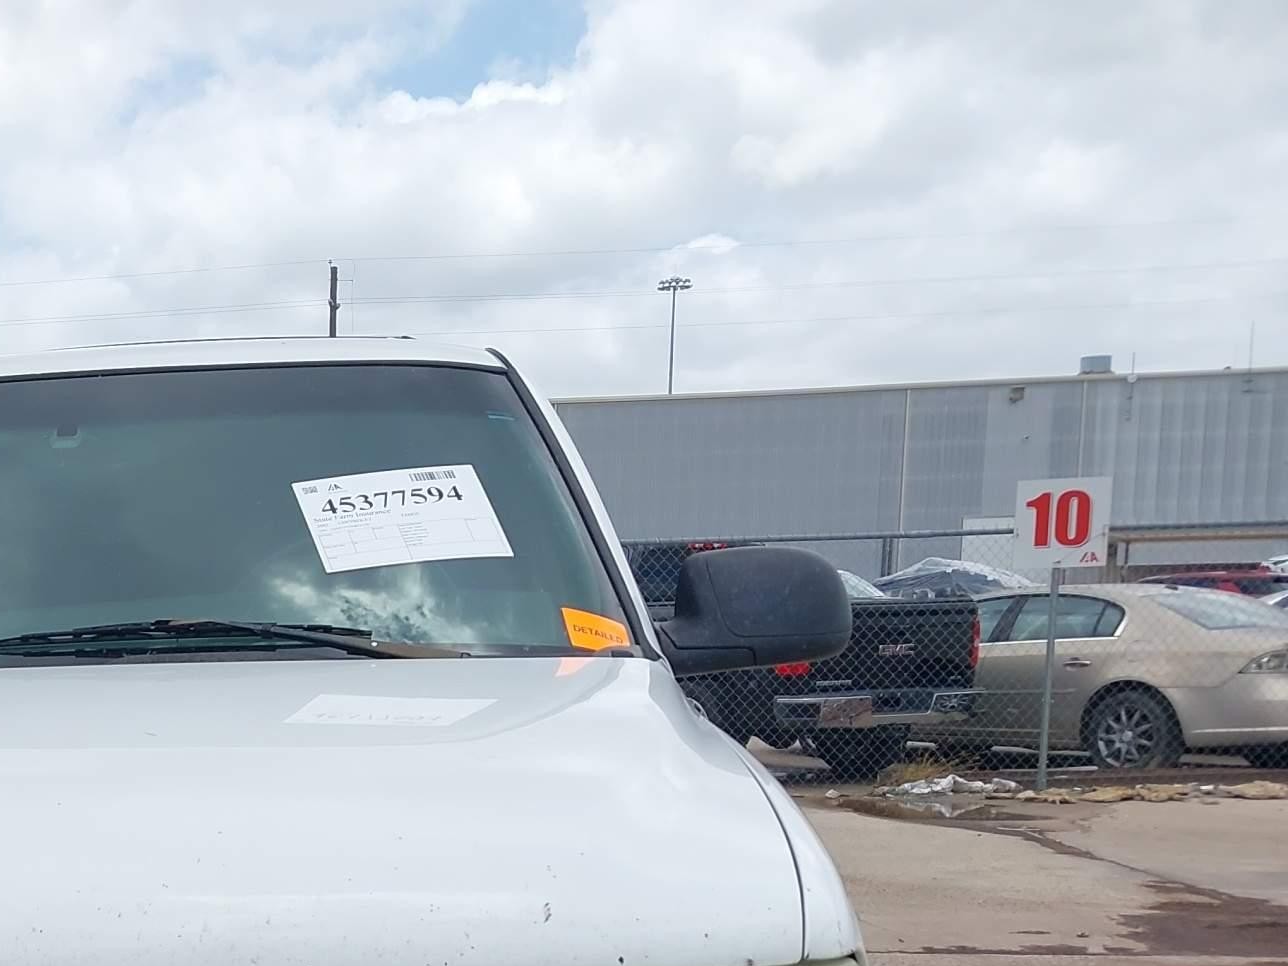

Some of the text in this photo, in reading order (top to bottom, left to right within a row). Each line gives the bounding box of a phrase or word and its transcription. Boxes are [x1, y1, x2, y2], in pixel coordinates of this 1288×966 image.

[321, 485, 464, 514] 45377594
[1026, 489, 1091, 548] 10
[573, 624, 623, 643] DETAILED
[879, 643, 916, 656] GMC
